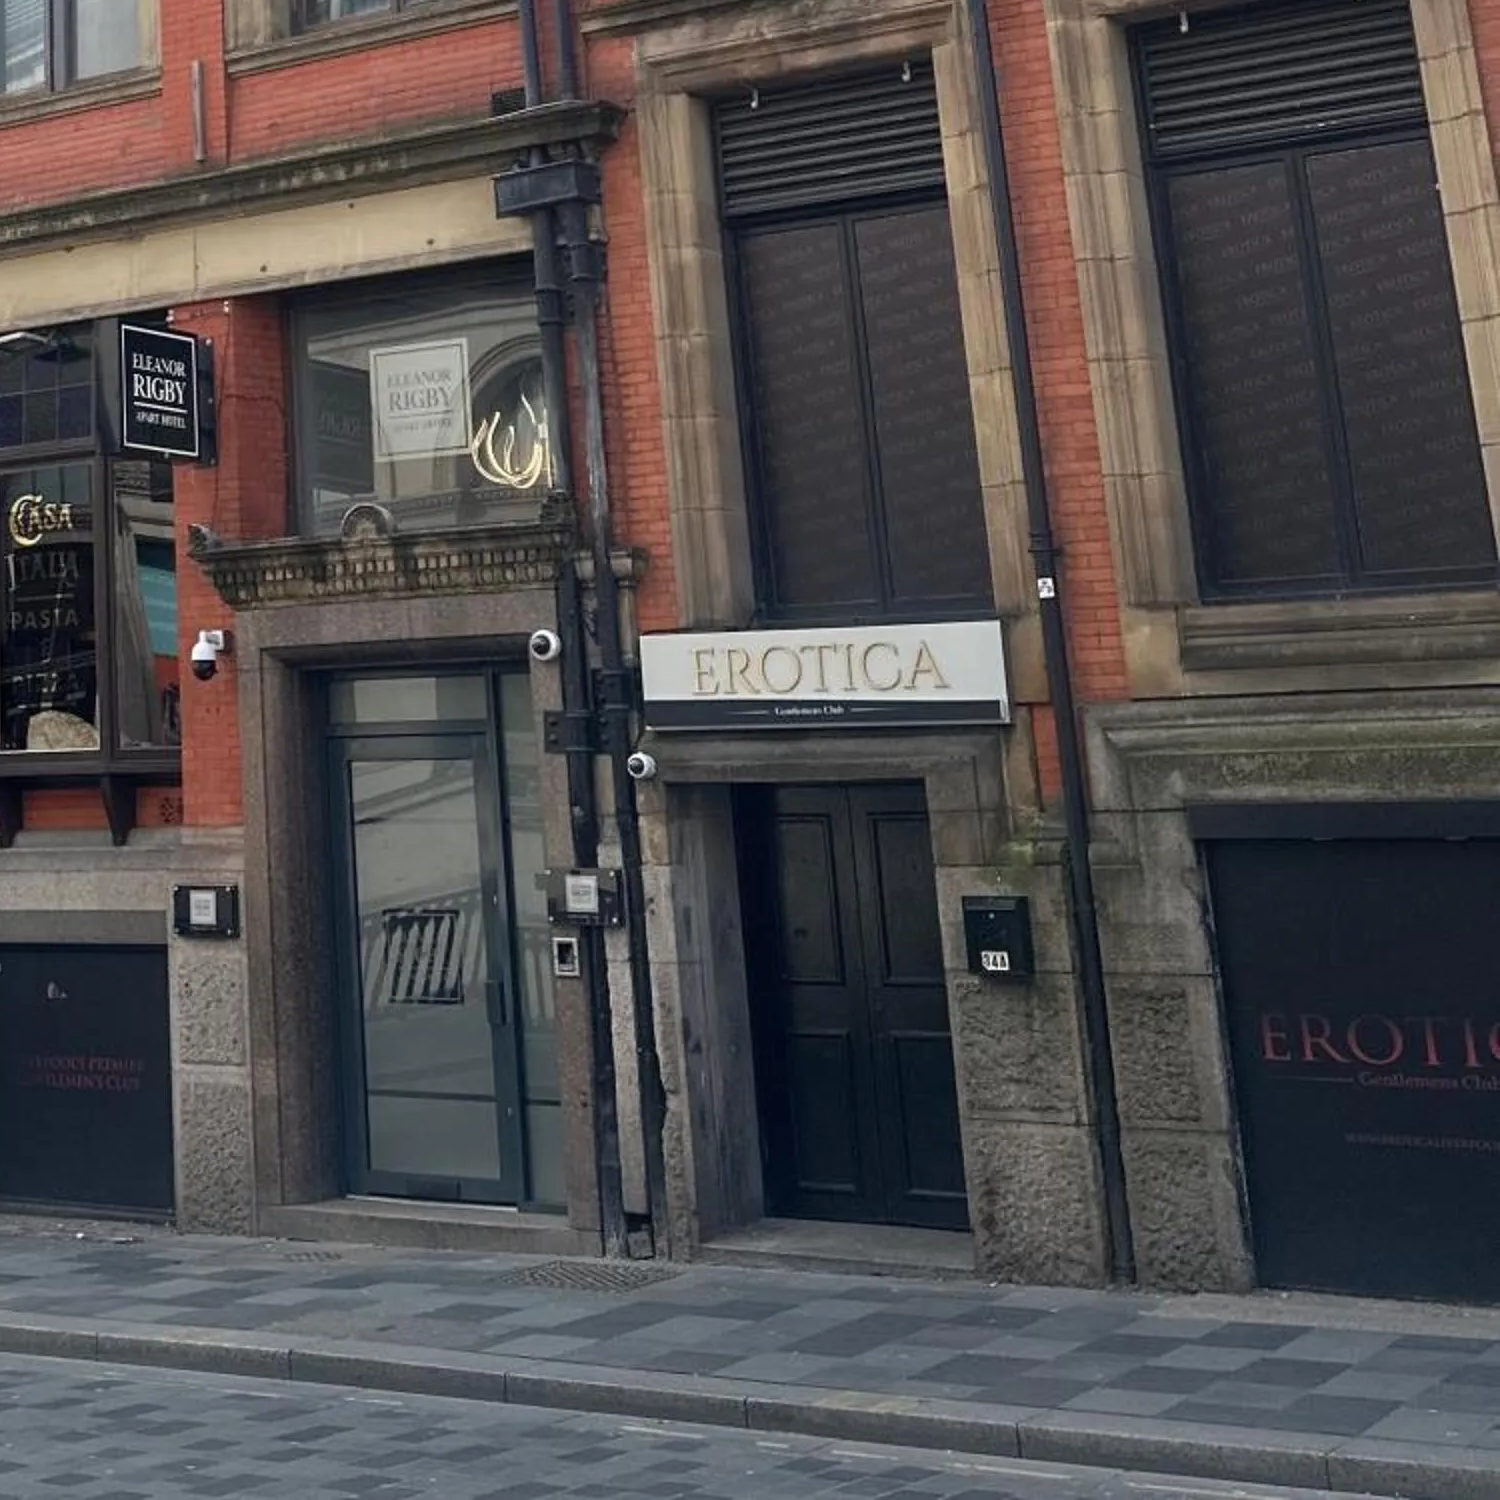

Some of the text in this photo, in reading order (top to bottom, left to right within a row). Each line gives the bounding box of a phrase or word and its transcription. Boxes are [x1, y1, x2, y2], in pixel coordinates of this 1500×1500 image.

[132, 353, 187, 377] ELEANOR
[133, 374, 187, 405] RIGBY
[389, 385, 451, 412] RIGBY
[11, 608, 78, 632] PASTA
[691, 640, 949, 696] EROTICA
[1260, 1011, 1500, 1068] EROTI
